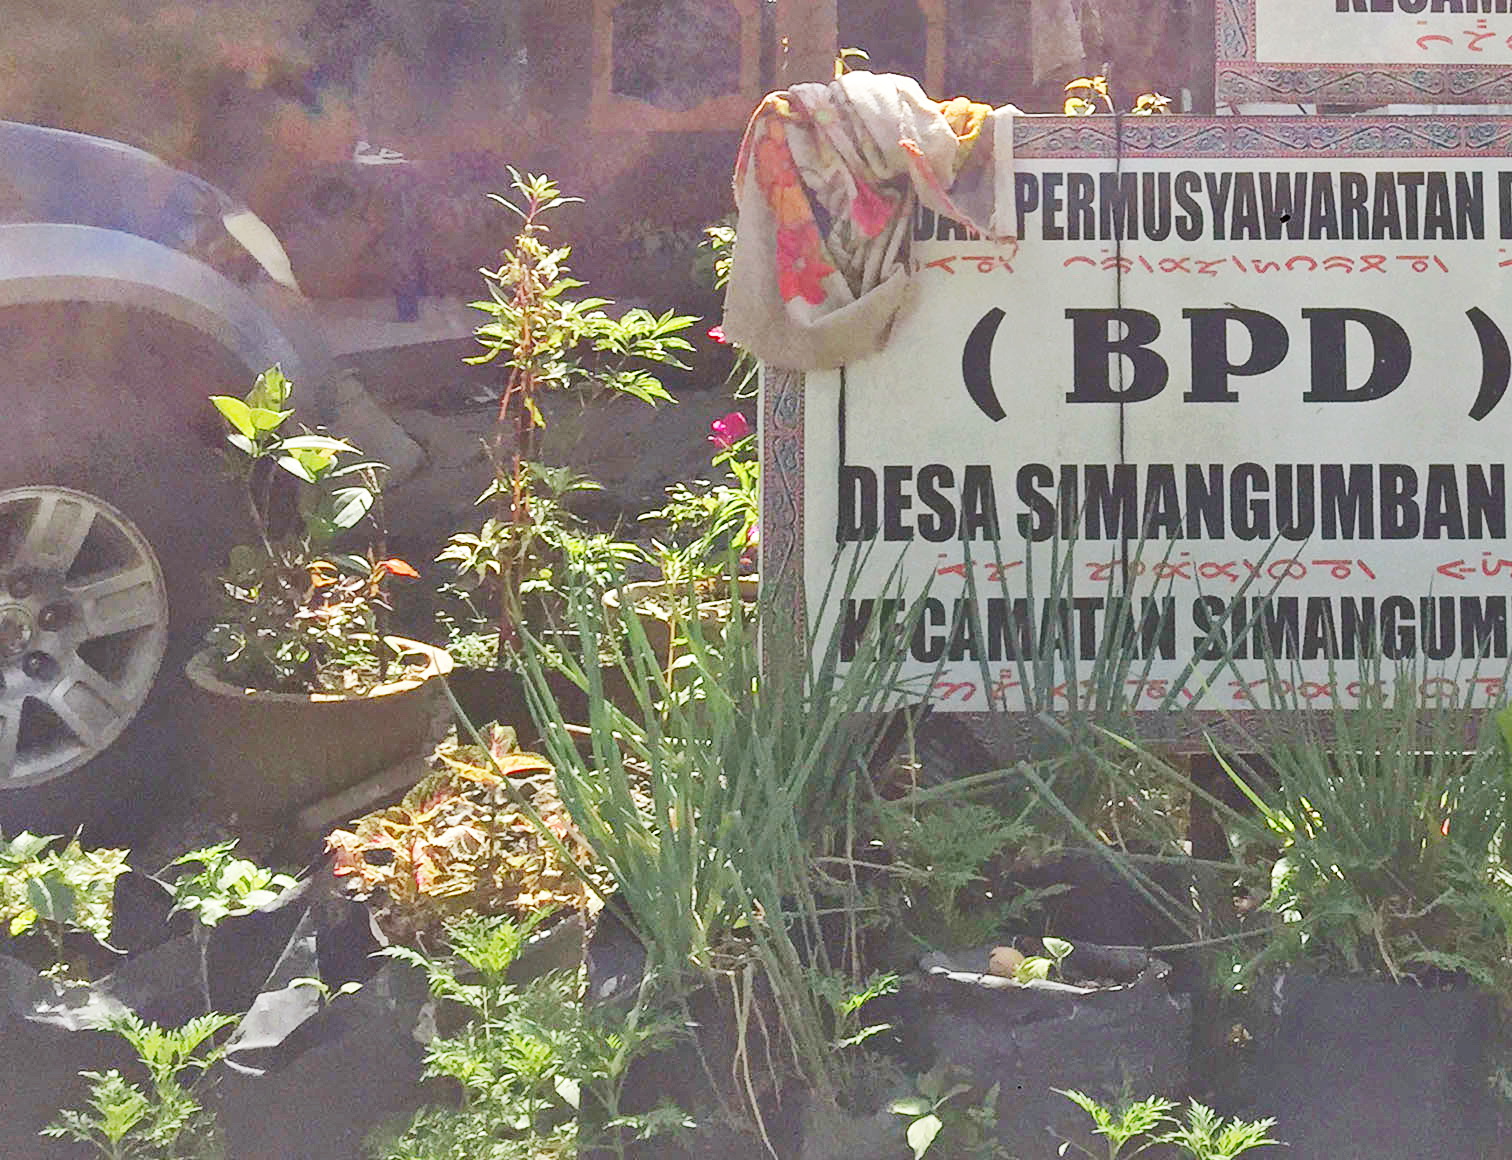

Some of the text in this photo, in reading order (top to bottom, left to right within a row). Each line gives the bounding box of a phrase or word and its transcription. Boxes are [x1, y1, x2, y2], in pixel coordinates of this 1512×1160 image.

[1014, 170, 1485, 241] PERMUSYAWARATAN
[1064, 306, 1413, 404] BPD
[837, 463, 1001, 542] DESA
[1016, 462, 1506, 542] SIMANGUMBAN
